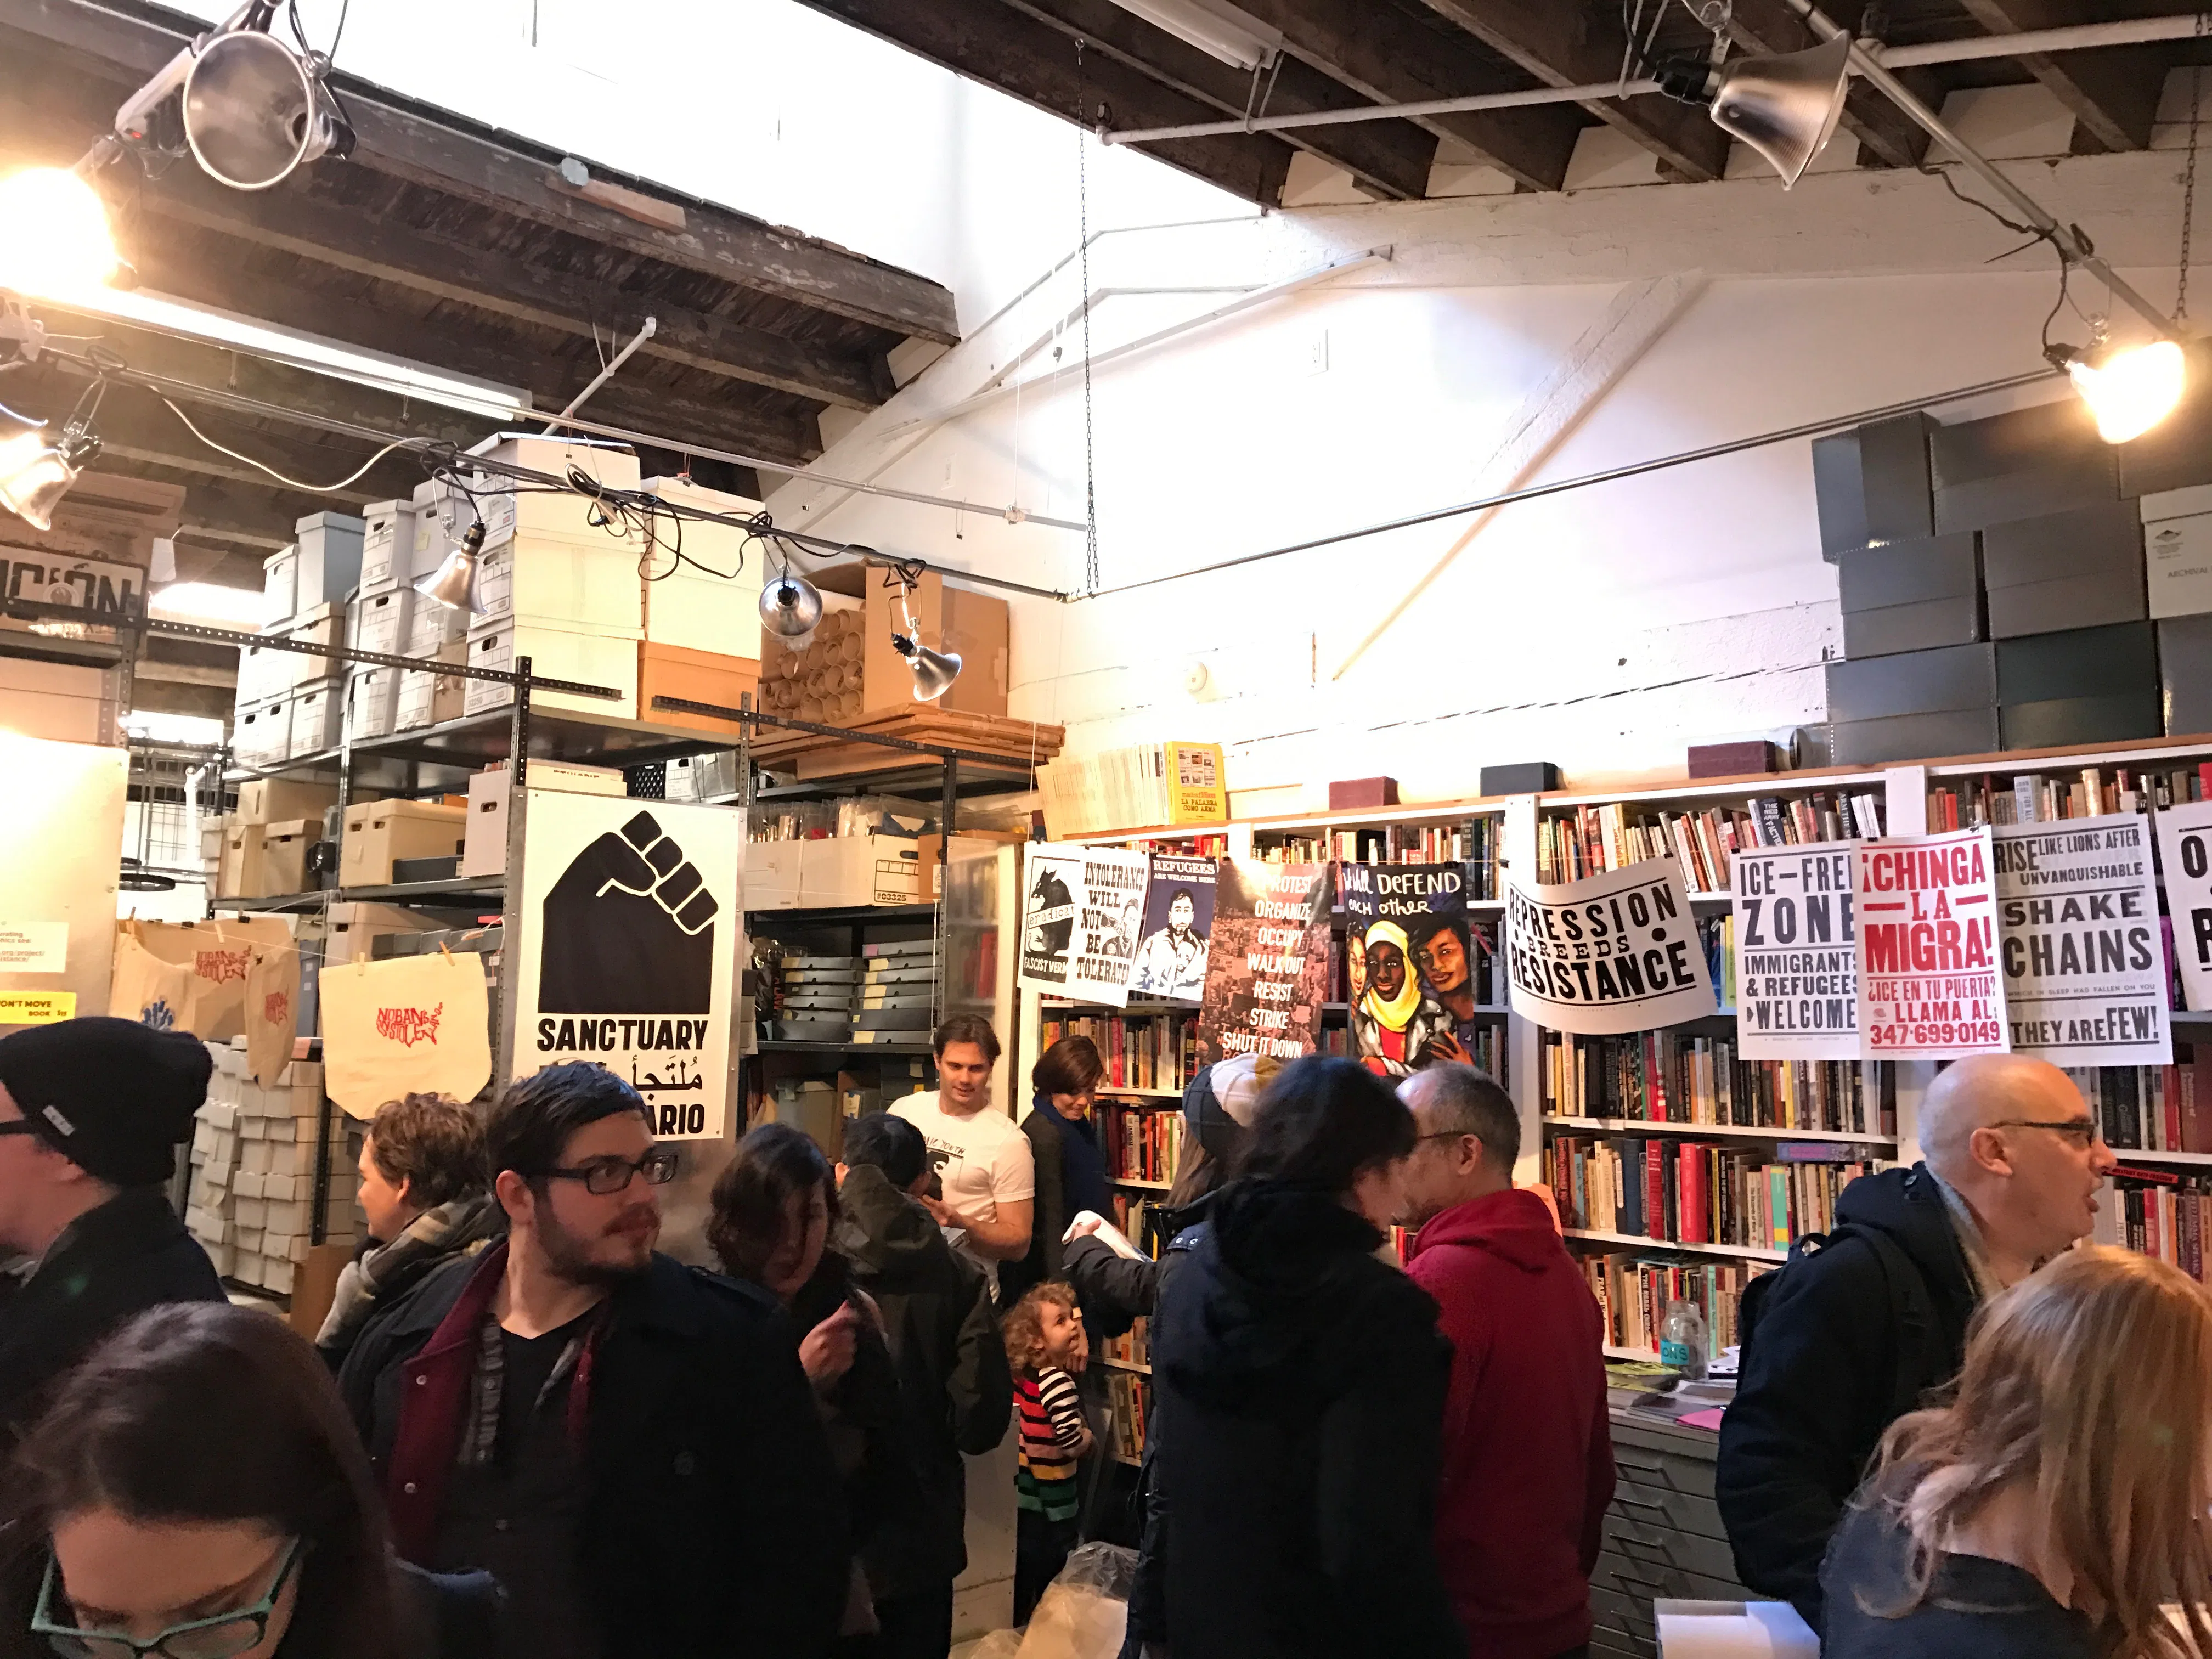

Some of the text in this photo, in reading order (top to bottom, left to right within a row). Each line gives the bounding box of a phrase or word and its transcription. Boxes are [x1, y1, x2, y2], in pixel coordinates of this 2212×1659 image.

[1765, 821, 1784, 846] FACTIO
[1993, 828, 2141, 873] RISE LIKE LIONS AFTER
[1153, 860, 1215, 875] REFUGEES
[1167, 874, 1197, 882] WELCOME
[2019, 862, 2143, 886] UNVANQUISHABLE
[1262, 875, 1313, 894] PROTEST
[1088, 890, 1120, 908] WILL
[1255, 900, 1312, 921] ORGANIZE
[1911, 889, 1951, 921] LA
[2005, 891, 2142, 927] SHAKE
[1029, 906, 1075, 925] eradicat
[1081, 908, 1101, 930] NOT
[1510, 883, 1677, 941] REPRESSION
[1742, 893, 1855, 946] ZONE
[1086, 933, 1101, 954] BE
[1257, 927, 1305, 947] OCCUPY
[1527, 935, 1630, 960] BREEDS
[1864, 916, 1994, 973] MIGRA!
[1248, 952, 1306, 974] WALK OUT
[2004, 927, 2152, 978] CHAINS
[1024, 957, 1068, 974] FASCIST VERM
[1511, 940, 1696, 1001] RESISTANCE
[1254, 980, 1294, 1002] RESIST
[1746, 978, 1759, 997] &
[1903, 980, 1921, 1001] EN
[1925, 979, 1941, 1000] TU
[1945, 975, 1996, 1000] PUERTA?
[1249, 1008, 1289, 1029] STRIKE
[1756, 998, 1856, 1029] WELCOME
[1895, 1001, 1962, 1023] LLAMA
[2105, 1005, 2159, 1041] FEW!
[537, 1018, 708, 1051] SANCTUARY
[2010, 1019, 2106, 1043] THEY ARE
[1222, 1031, 1258, 1053] SHUT
[1258, 1037, 1270, 1055] IT
[1270, 1038, 1303, 1059] DOWN
[940, 1139, 966, 1154] YOUTH
